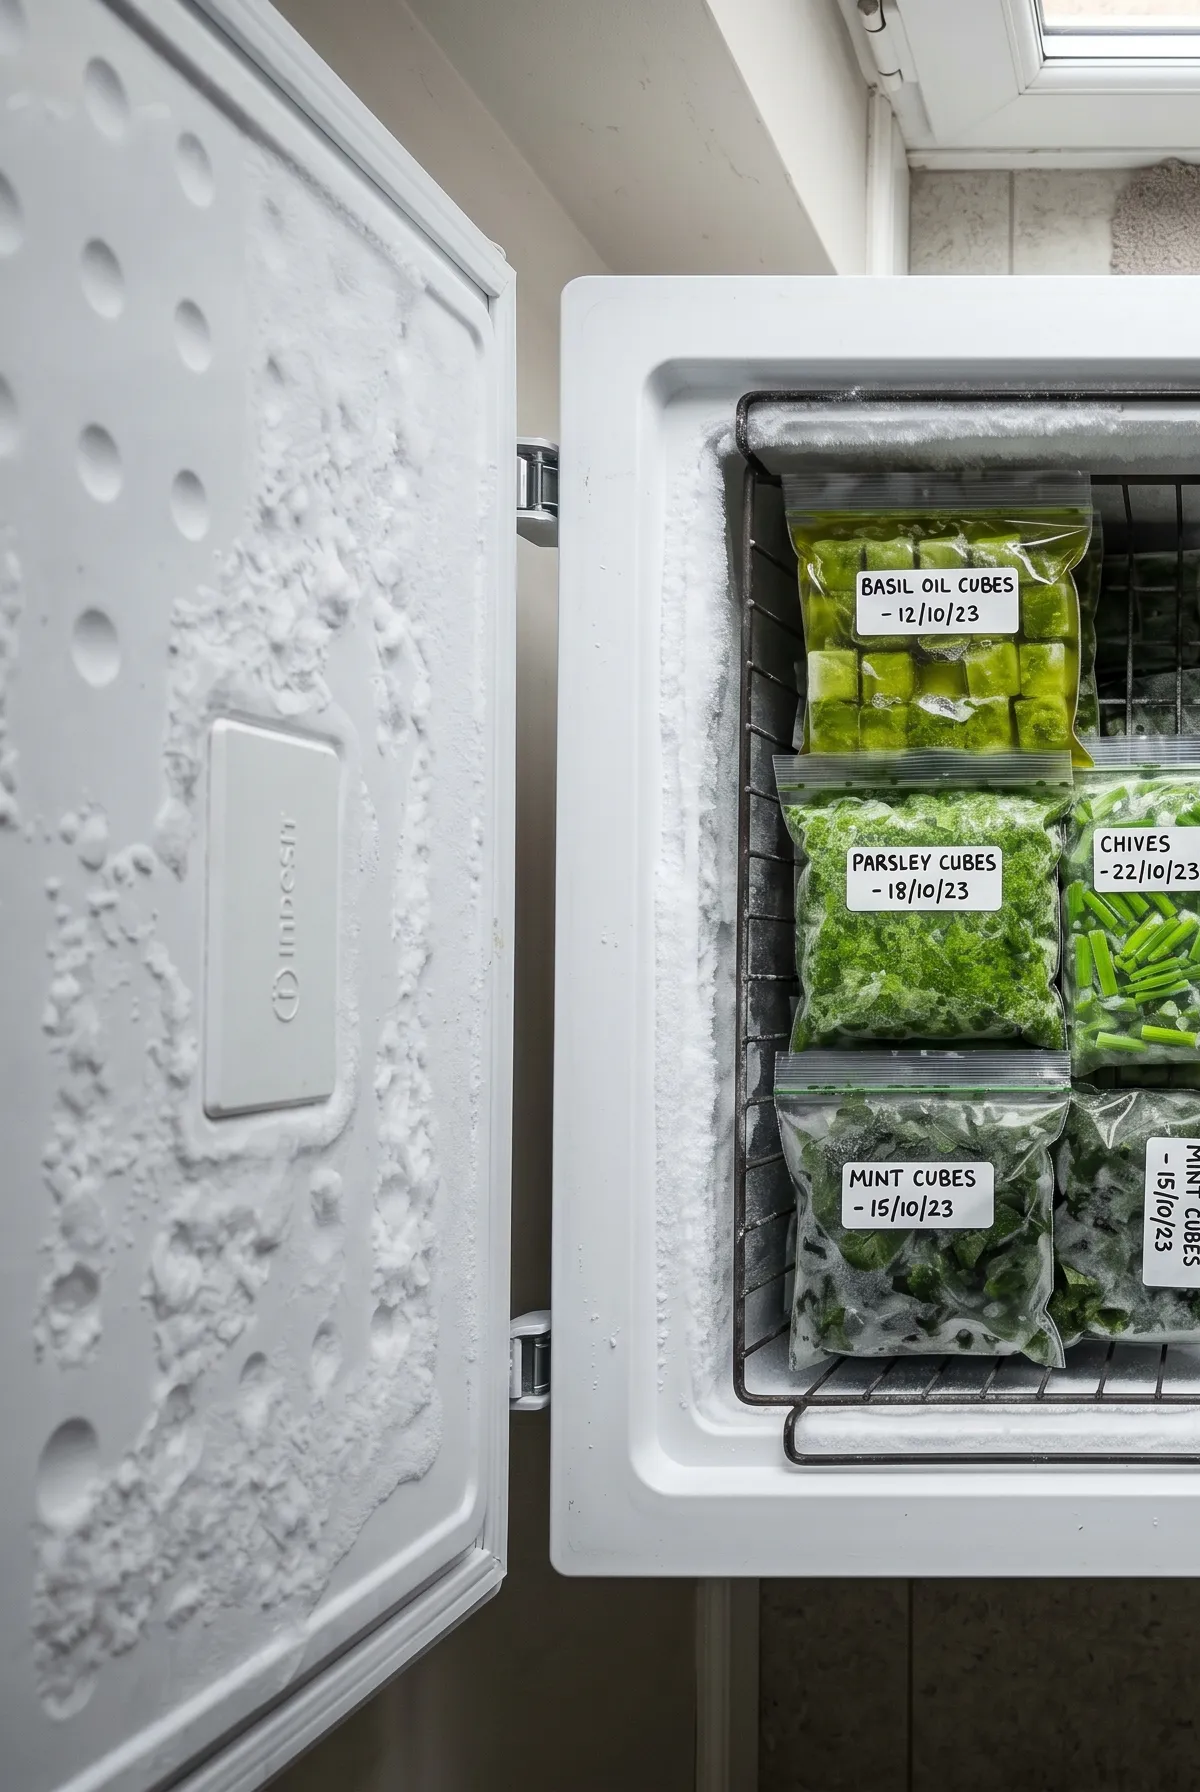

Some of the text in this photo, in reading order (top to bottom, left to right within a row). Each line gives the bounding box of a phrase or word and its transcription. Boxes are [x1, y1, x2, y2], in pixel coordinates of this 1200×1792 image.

[861, 576, 1014, 597] BASIL OIL CUBES
[899, 602, 980, 627] 12/10/23
[1100, 834, 1171, 853] CHIVES
[852, 853, 997, 872] PARSLEY CUBES
[888, 878, 969, 905] 18/10/23
[849, 1168, 977, 1189] MINT CUBES
[870, 1194, 954, 1223] 15/10/23
[1149, 1171, 1180, 1252] 15/10/23
